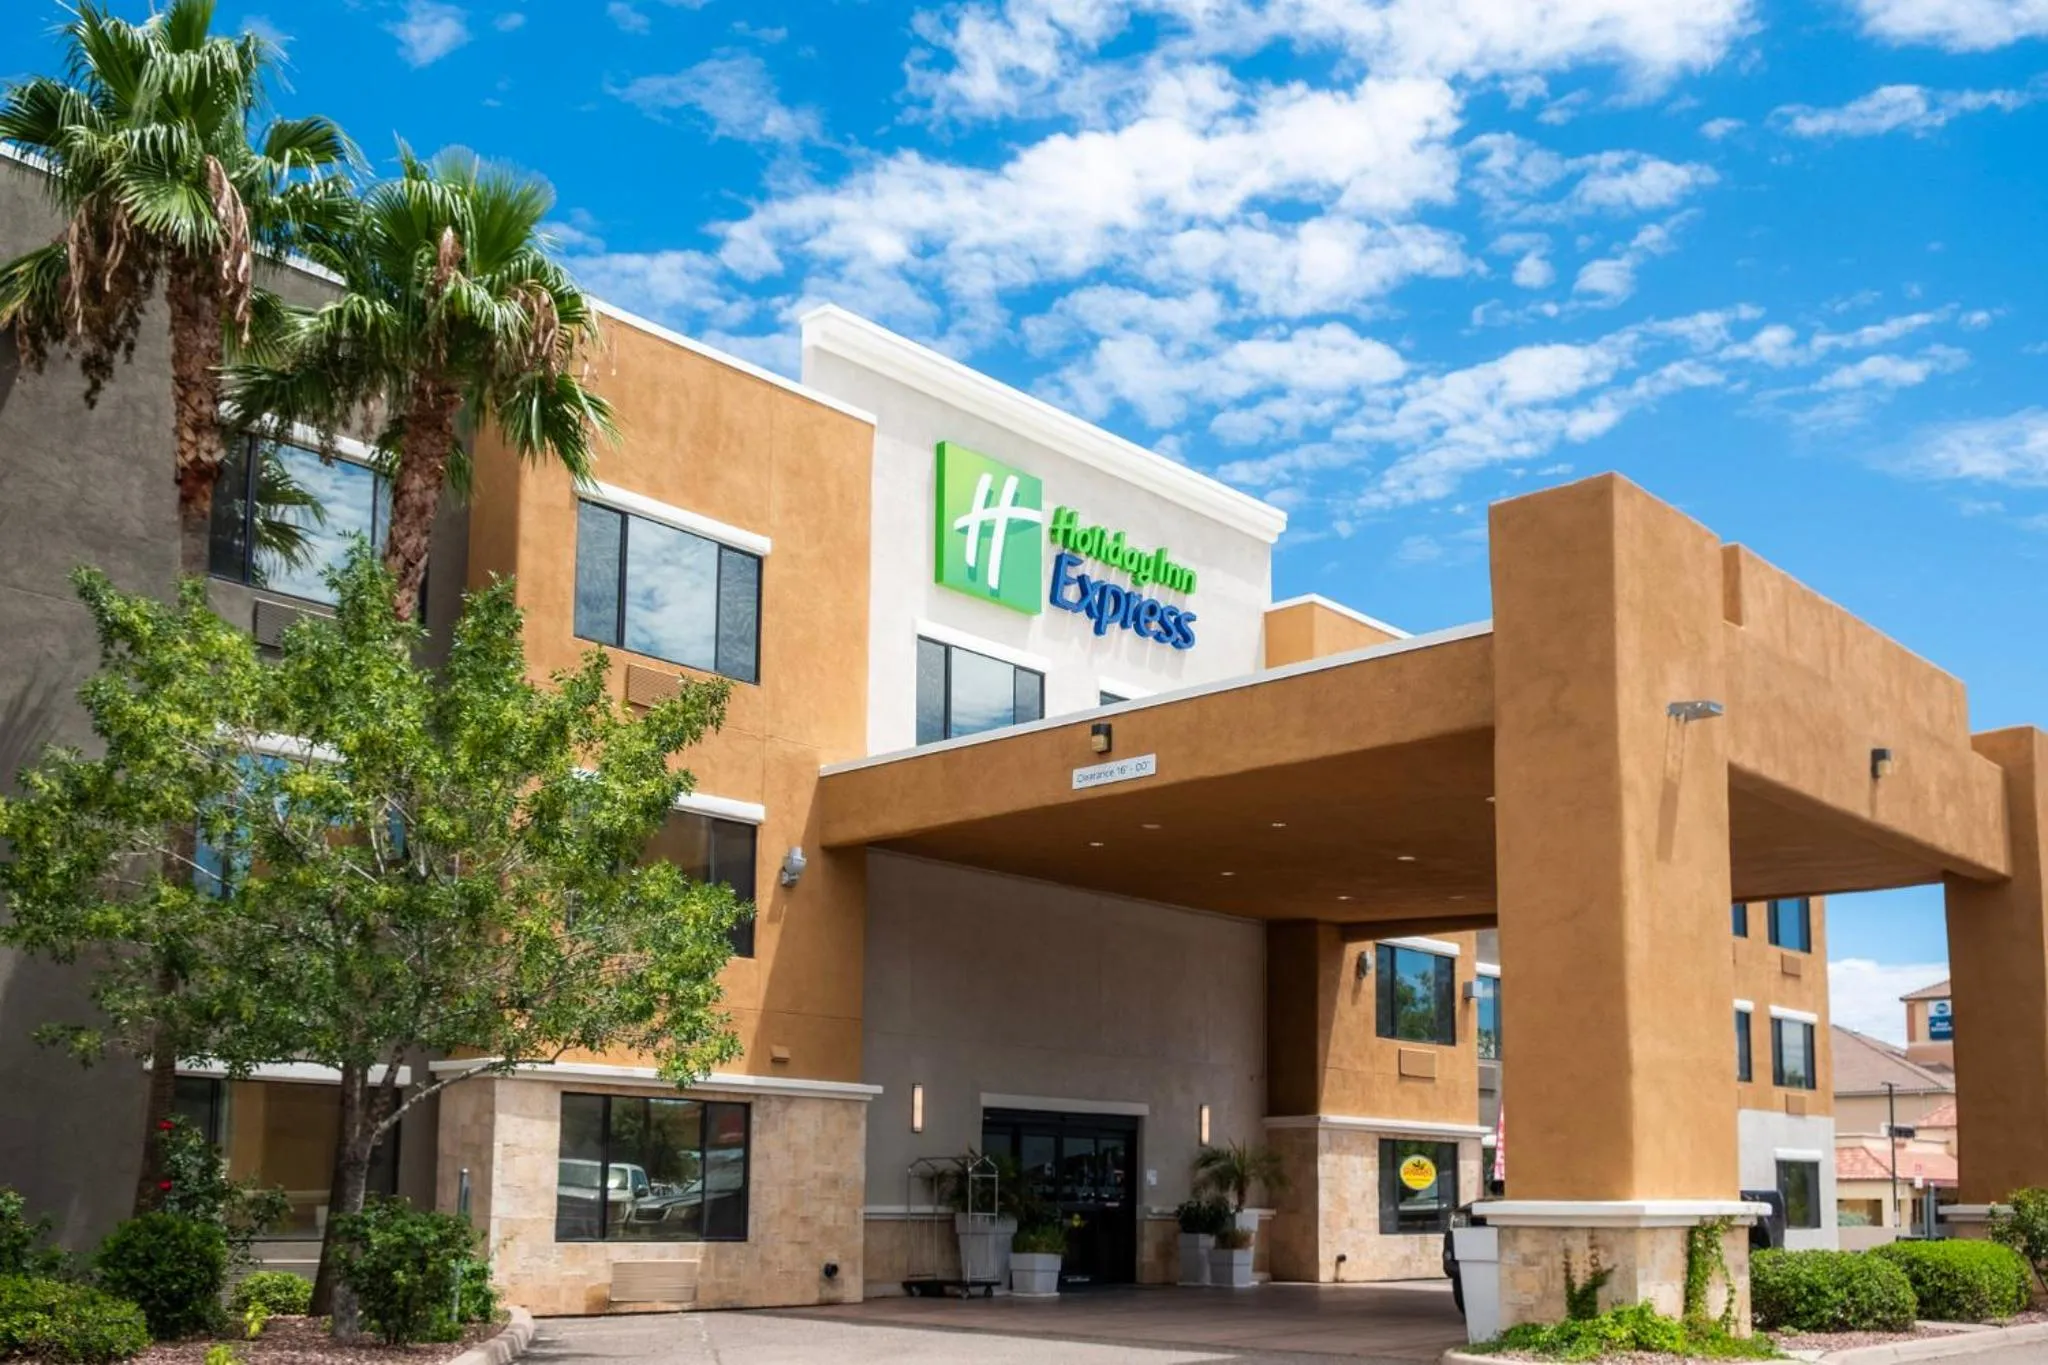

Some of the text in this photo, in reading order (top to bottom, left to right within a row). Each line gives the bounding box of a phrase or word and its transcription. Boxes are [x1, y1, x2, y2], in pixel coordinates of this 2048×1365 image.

[1049, 505, 1197, 594] Holiday Inn
[1049, 553, 1197, 650] Express
